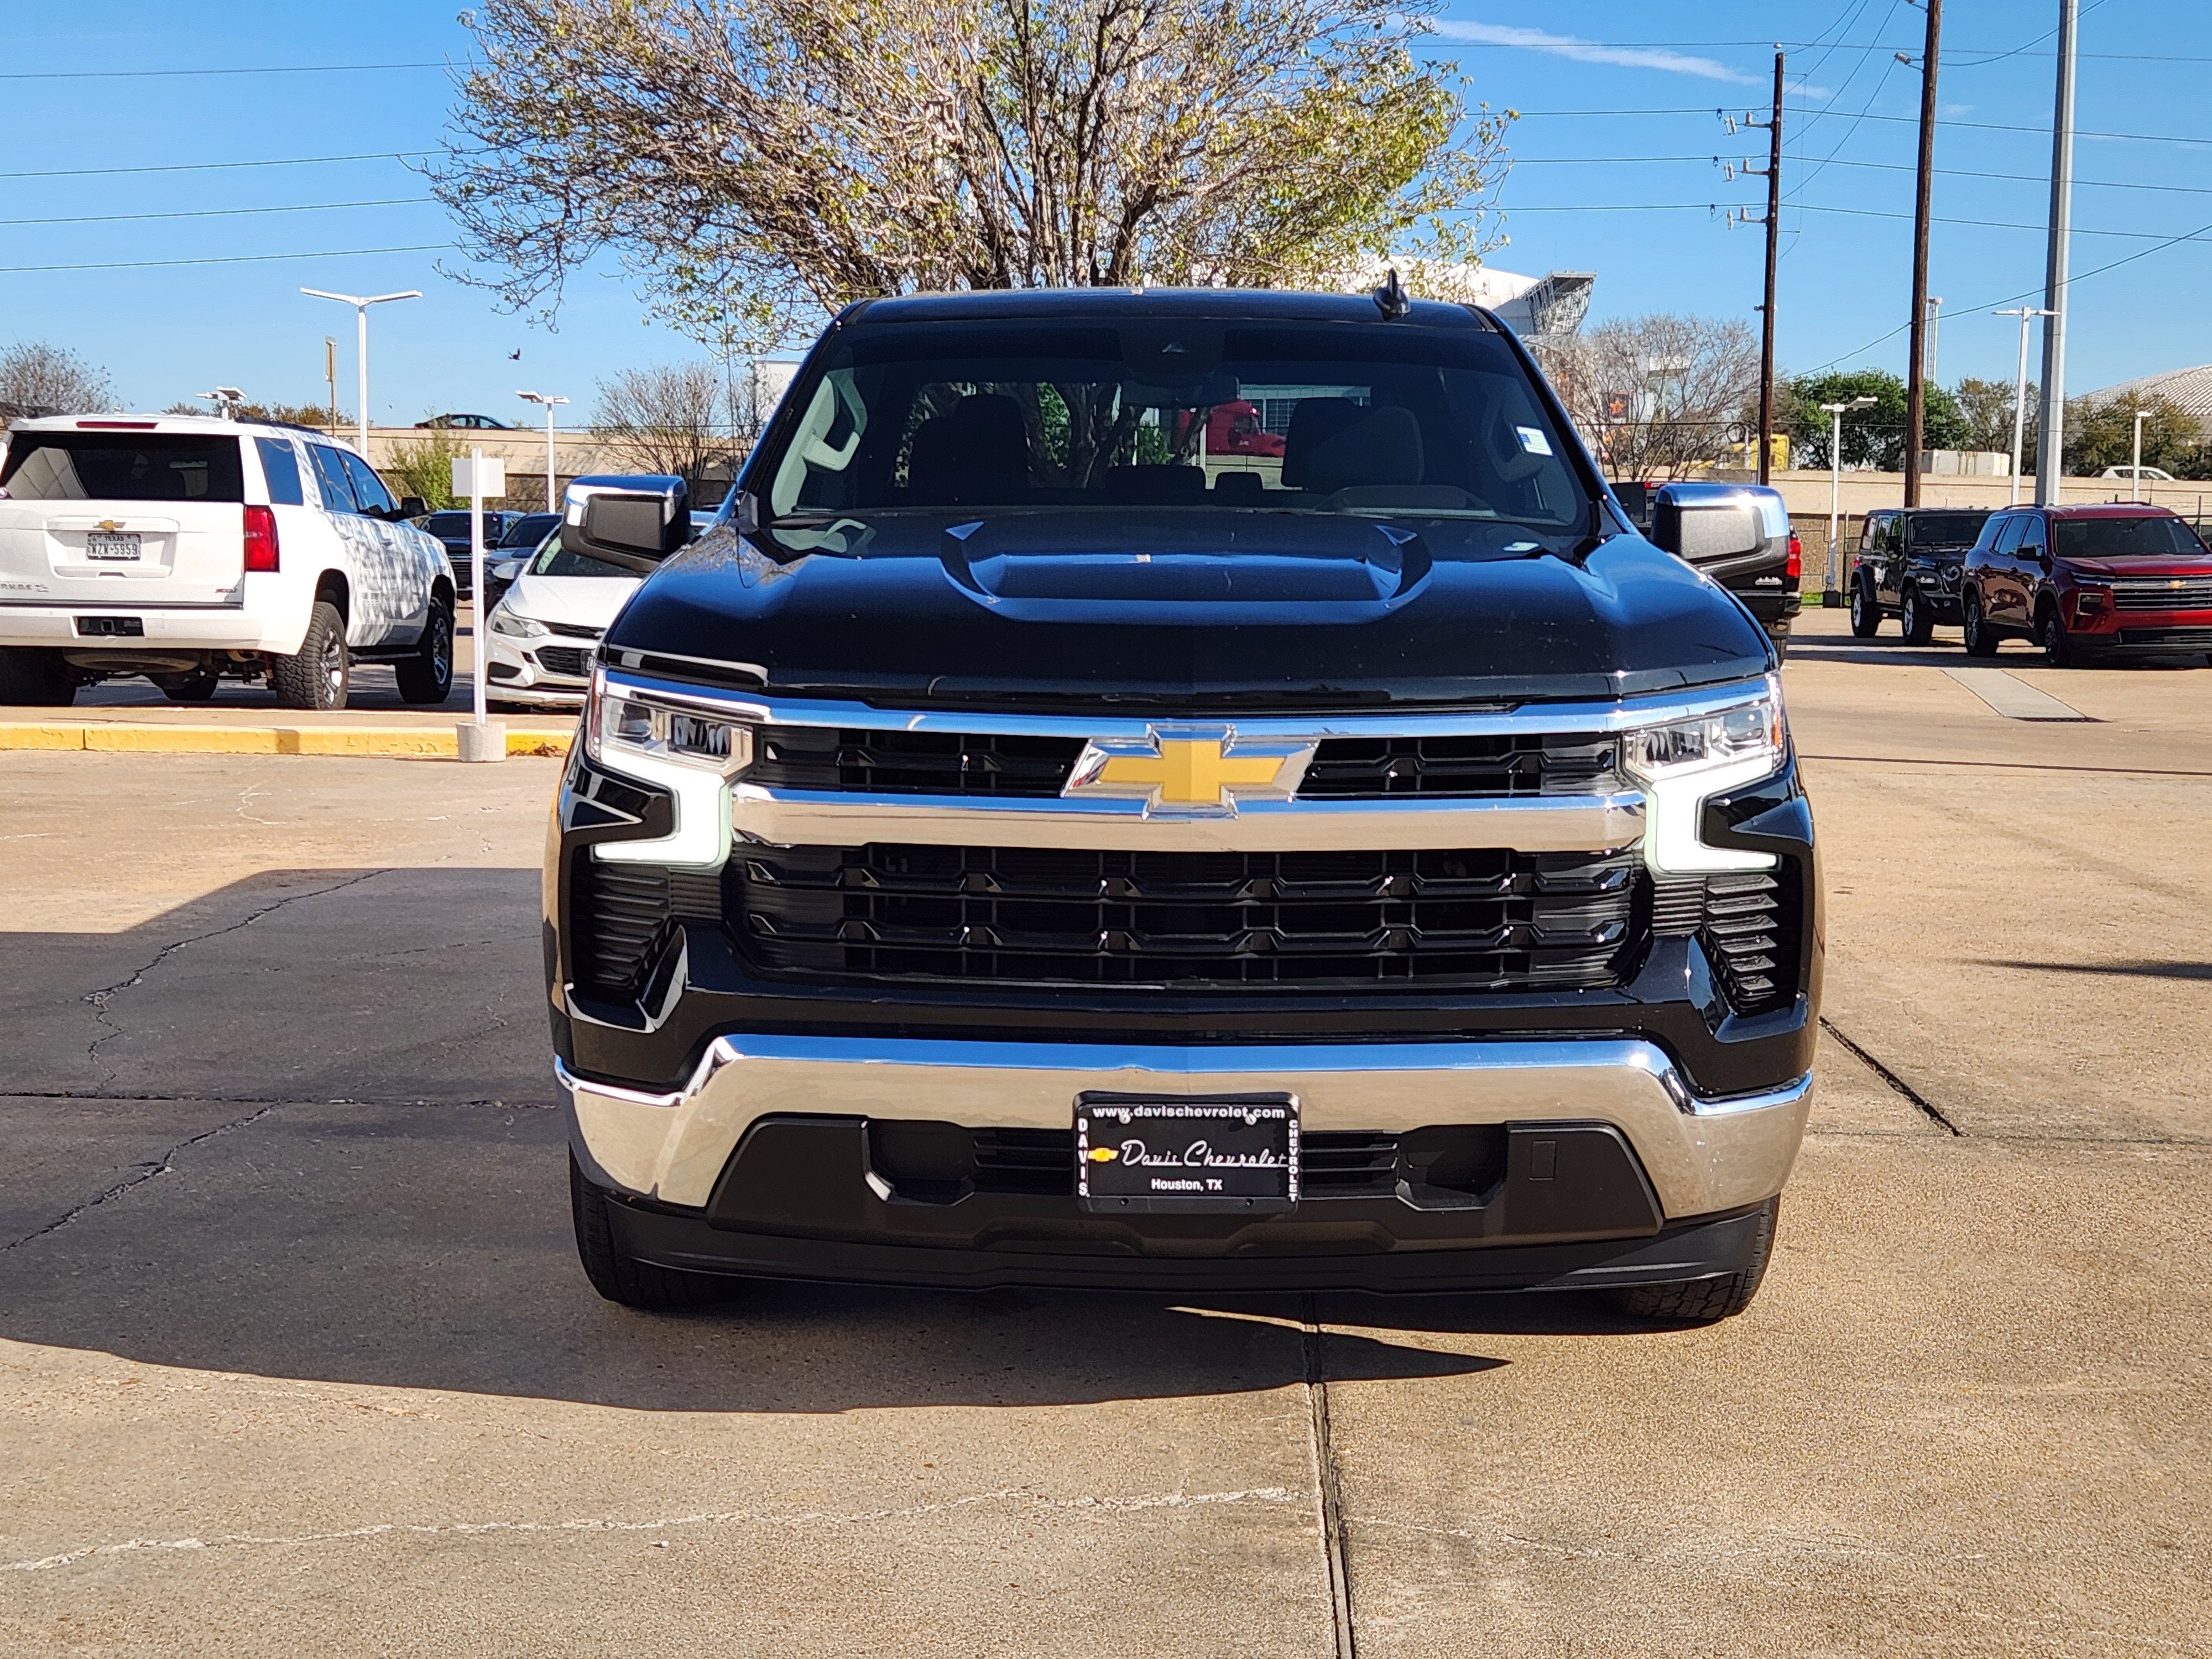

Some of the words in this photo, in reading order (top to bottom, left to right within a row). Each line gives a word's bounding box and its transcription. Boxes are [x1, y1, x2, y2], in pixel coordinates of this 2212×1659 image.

[1092, 1104, 1285, 1119] www.davischevroletcom
[1120, 1139, 1183, 1166] Davis
[1184, 1140, 1289, 1168] Chevrolet
[1288, 1119, 1298, 1202] CHEVROLET
[1151, 1178, 1204, 1192] Houston,
[1206, 1178, 1223, 1191] TX
